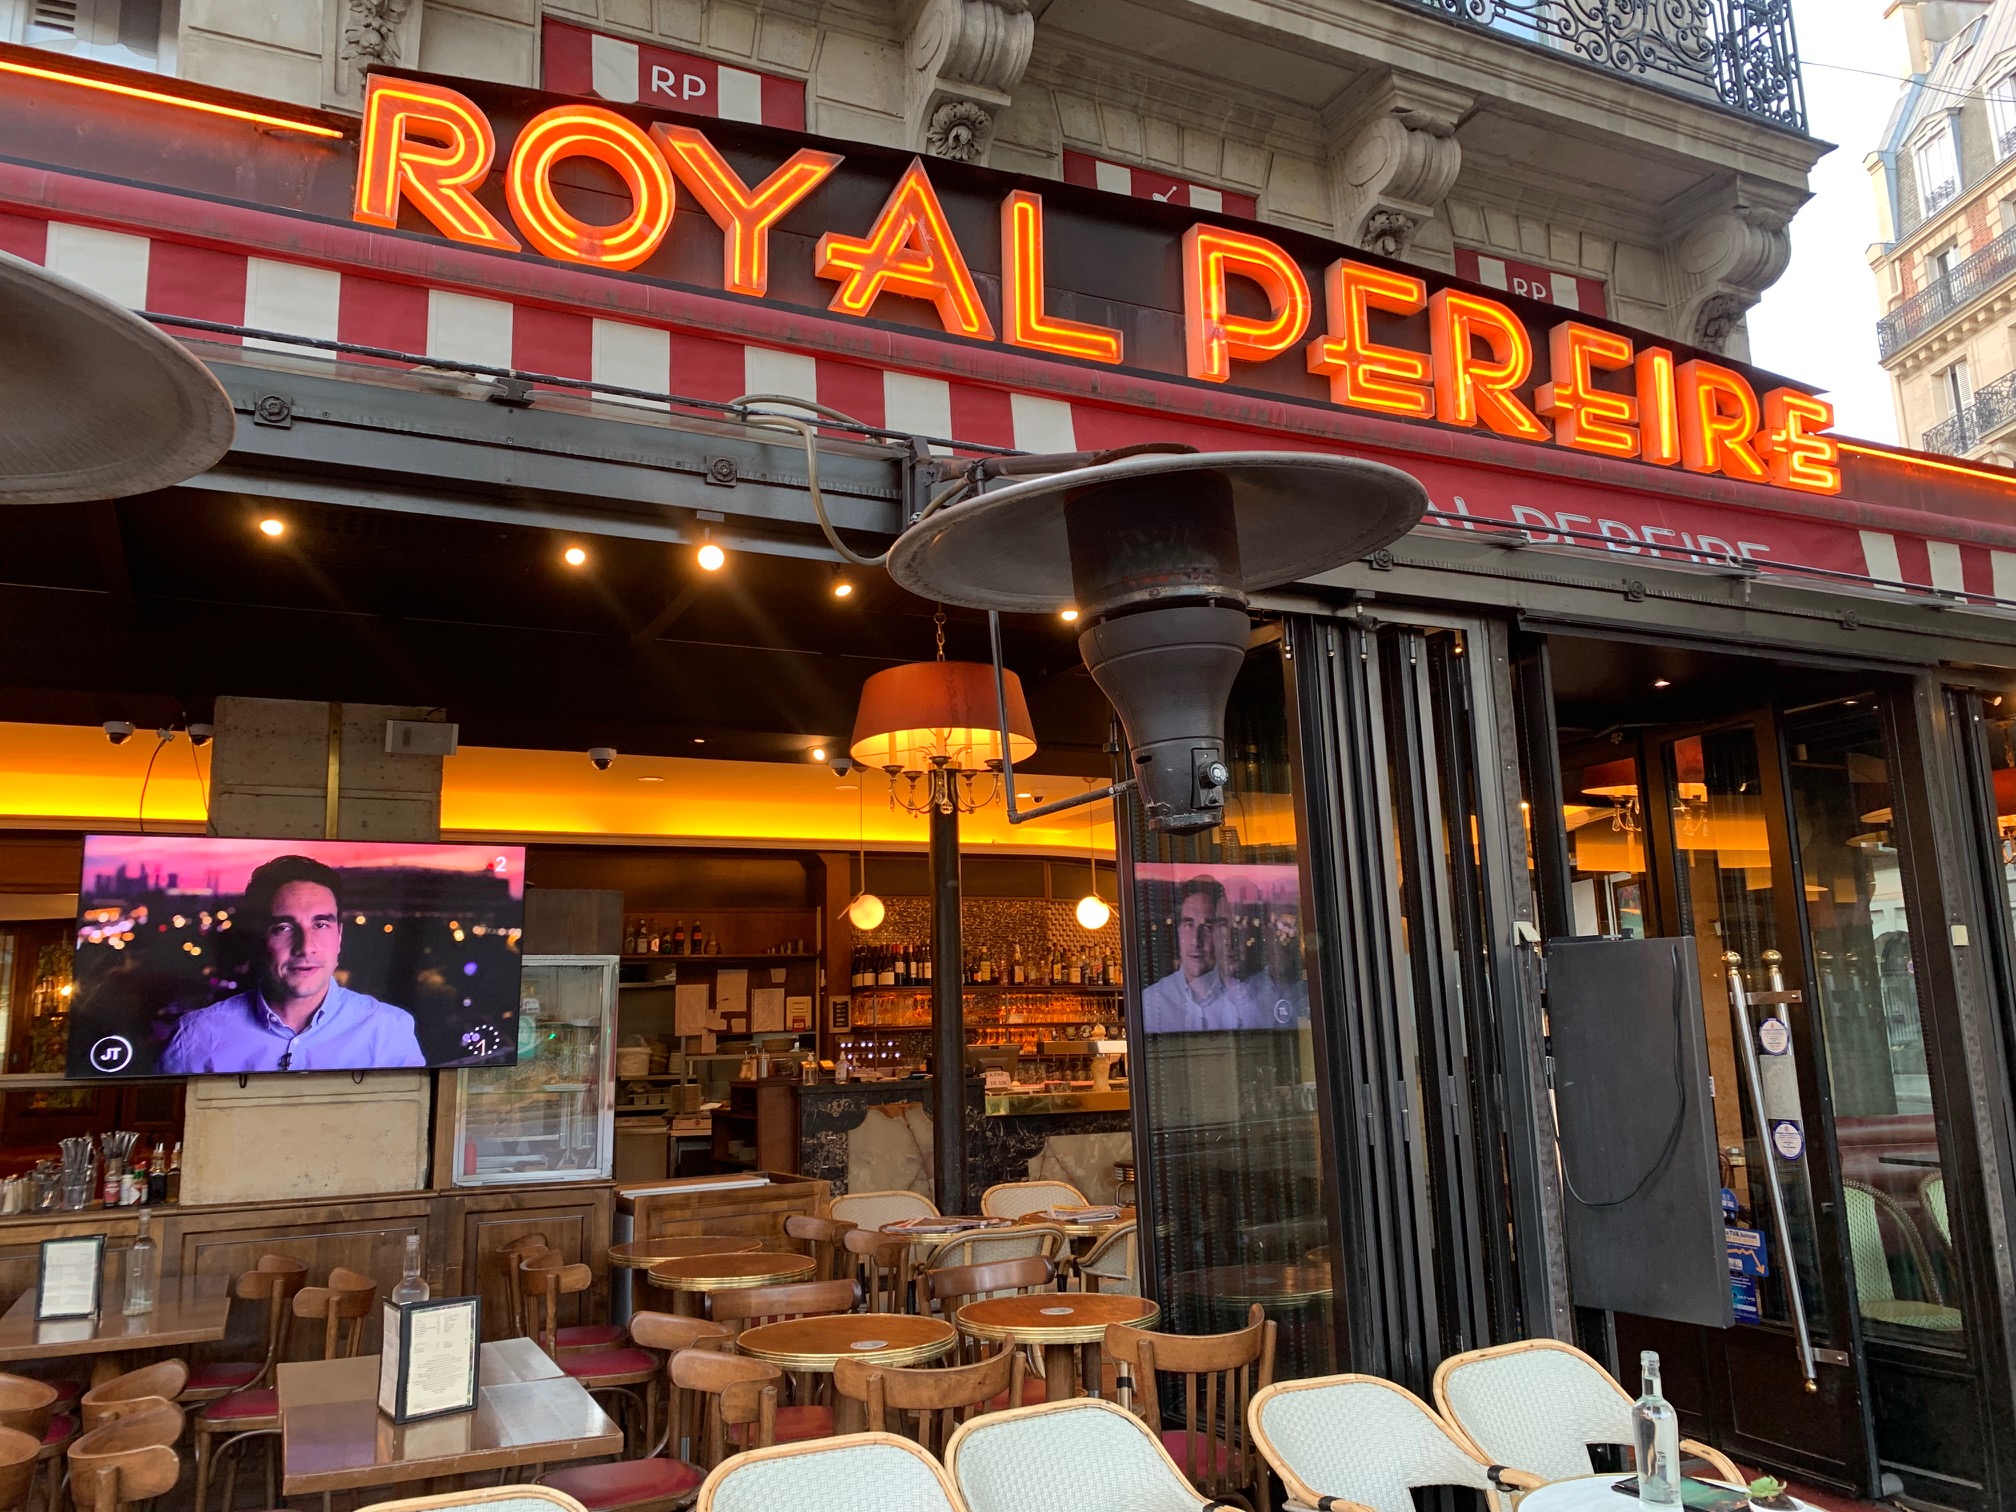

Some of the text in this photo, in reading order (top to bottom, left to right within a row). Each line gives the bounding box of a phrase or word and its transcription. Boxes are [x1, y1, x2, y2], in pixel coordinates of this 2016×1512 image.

[651, 65, 706, 100] RP
[354, 74, 1841, 495] ROYAL PEREIRE
[1513, 277, 1547, 300] RP
[495, 856, 507, 872] 2
[101, 1047, 122, 1060] JT
